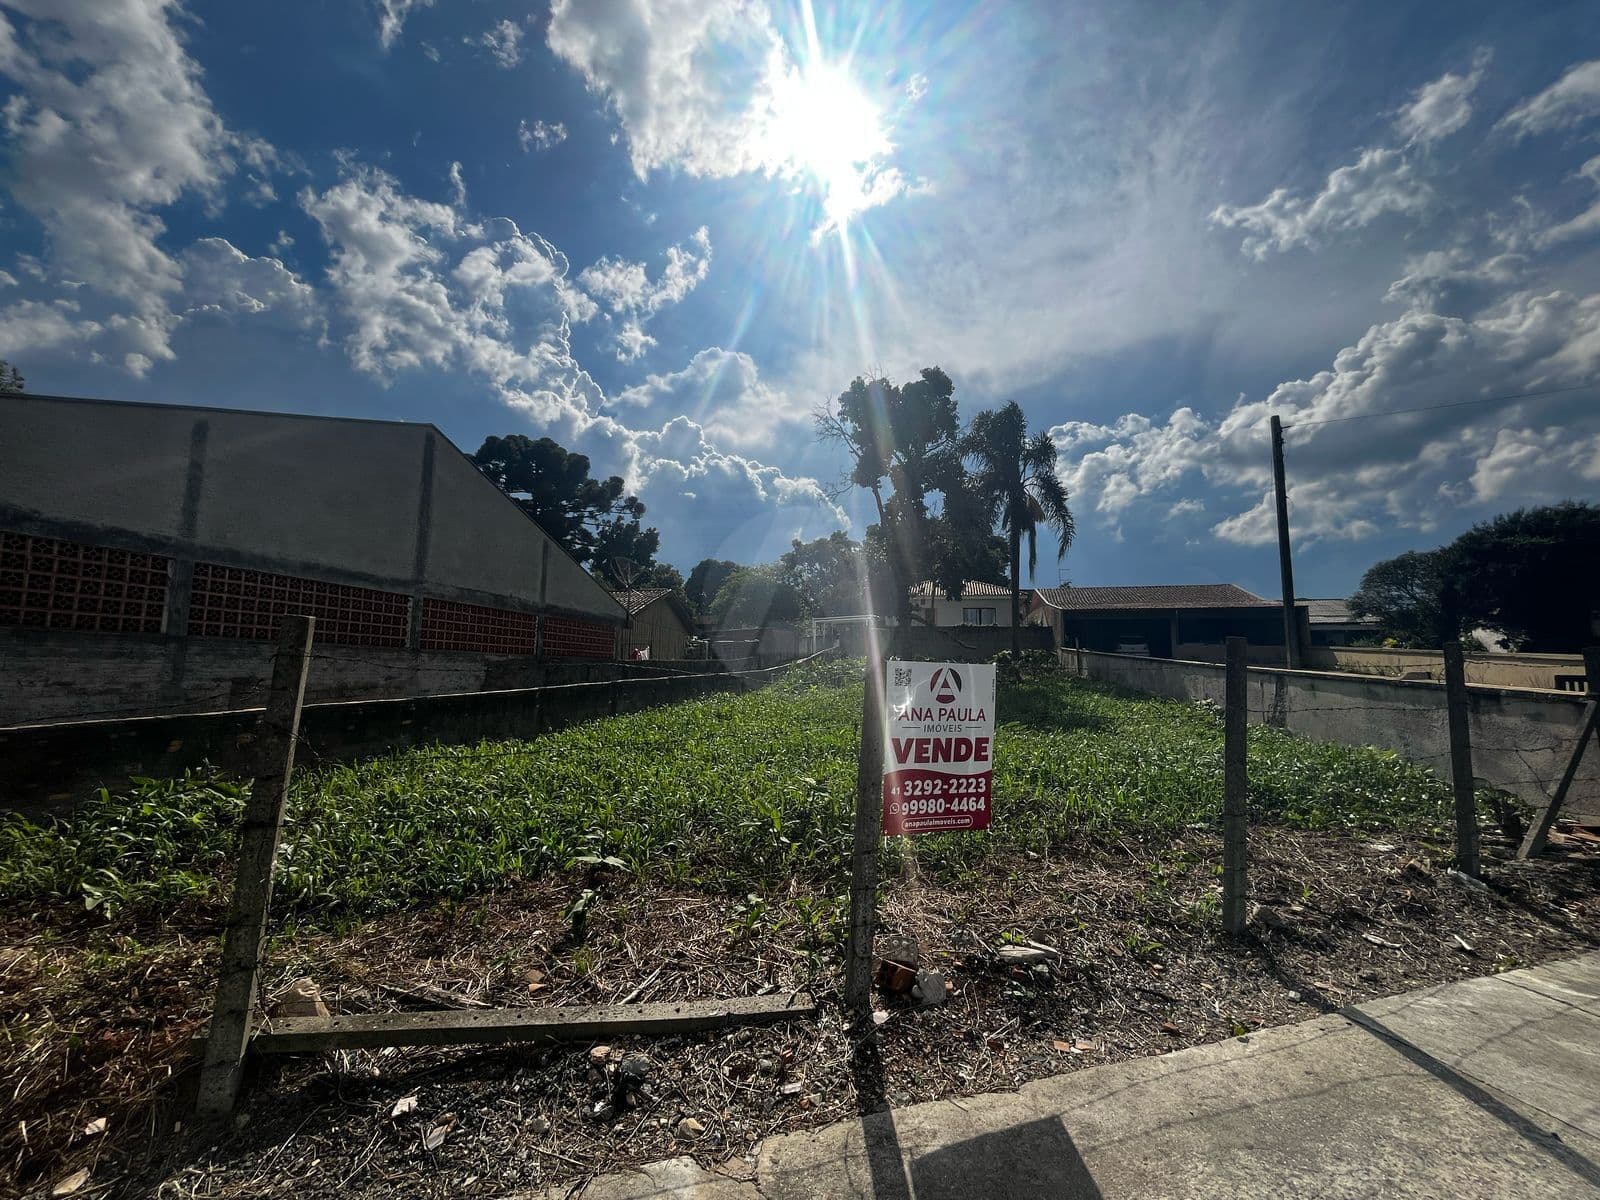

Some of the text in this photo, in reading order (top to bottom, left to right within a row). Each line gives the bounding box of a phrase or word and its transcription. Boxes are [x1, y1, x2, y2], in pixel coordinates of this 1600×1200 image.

[898, 707, 986, 722] ANA PAULA
[891, 737, 990, 764] VENDE
[890, 778, 986, 796] 41 3292-2223
[901, 796, 986, 816] 99980-4464
